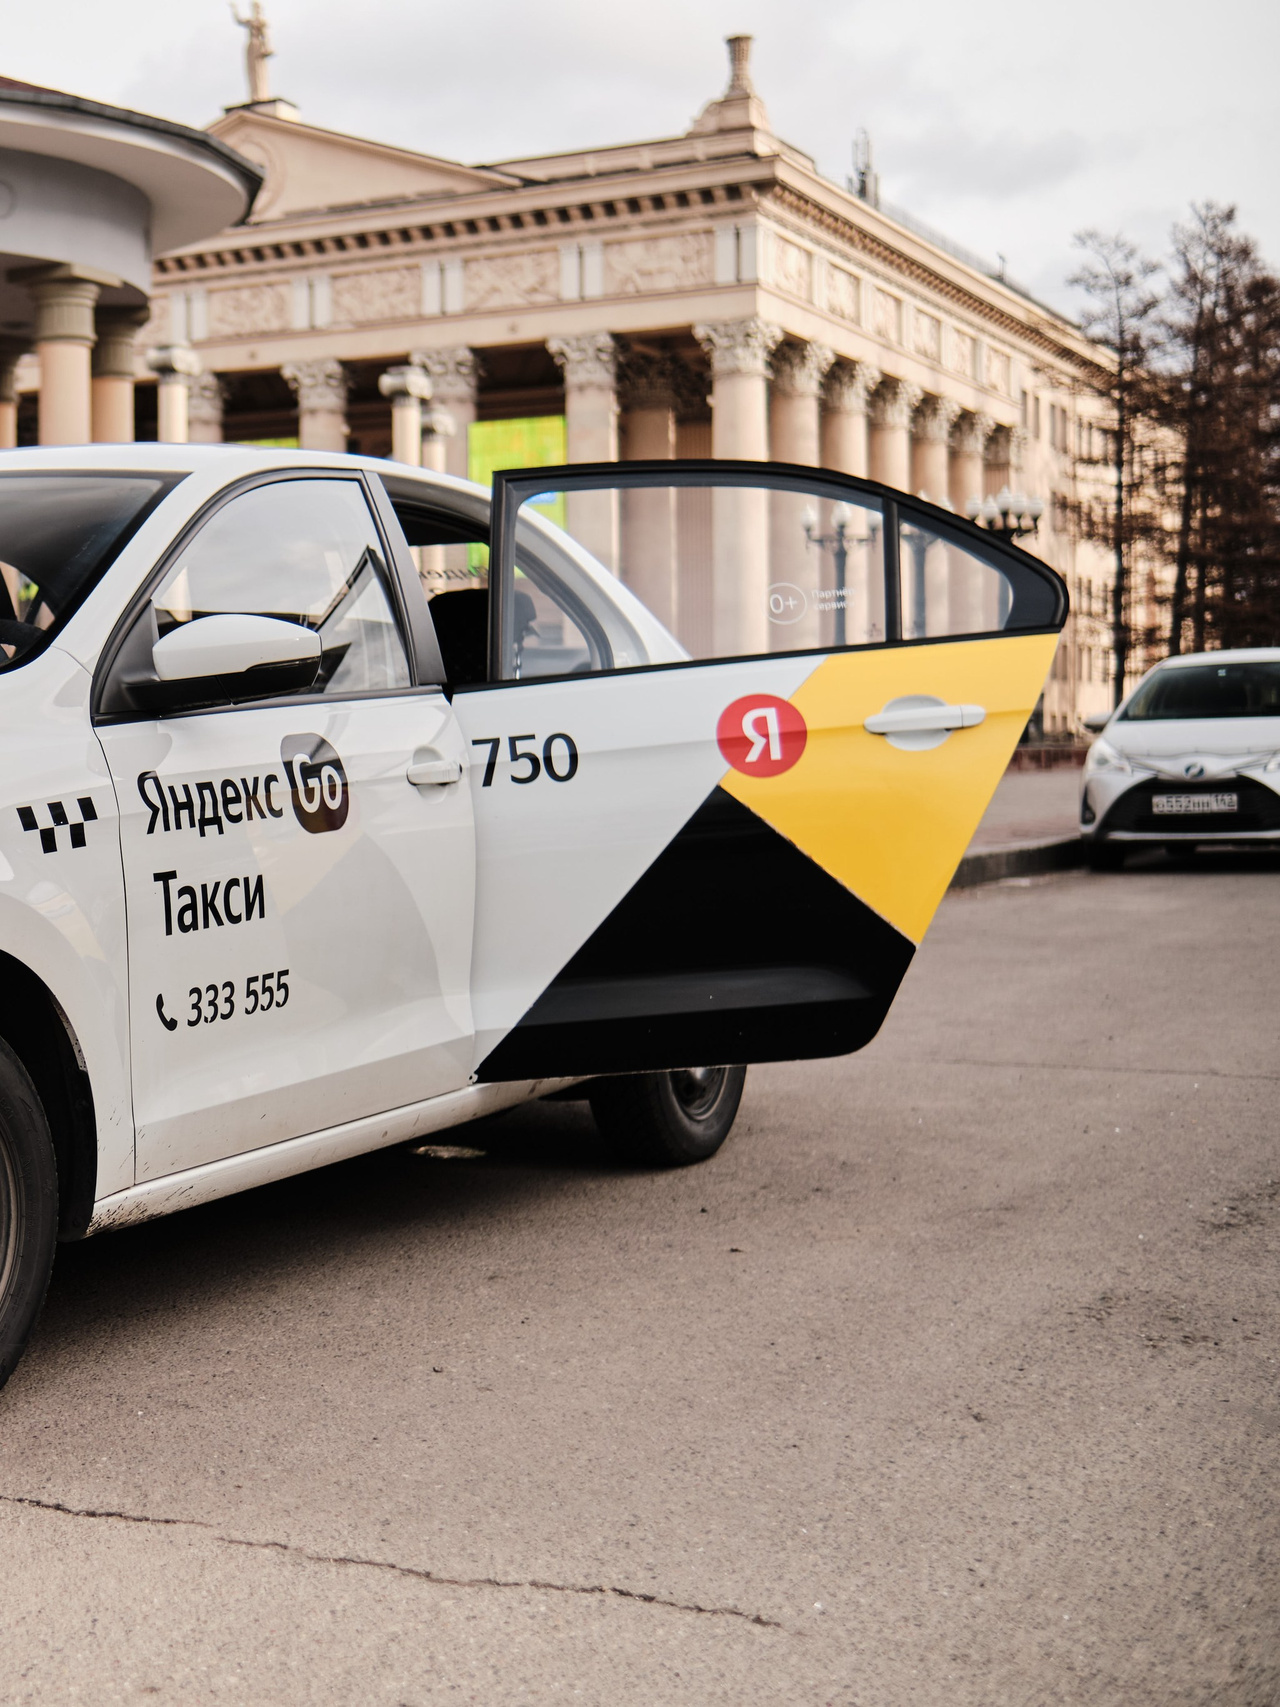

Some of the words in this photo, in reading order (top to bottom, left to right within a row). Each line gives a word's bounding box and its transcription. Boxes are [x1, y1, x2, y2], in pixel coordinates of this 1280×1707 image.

[770, 593, 798, 614] 0+
[472, 733, 580, 788] 750
[742, 706, 782, 764] Я
[137, 771, 285, 838] Яндекс
[289, 753, 345, 814] Go
[153, 869, 266, 936] Такси
[186, 980, 236, 1029] 333
[245, 969, 291, 1016] 555
